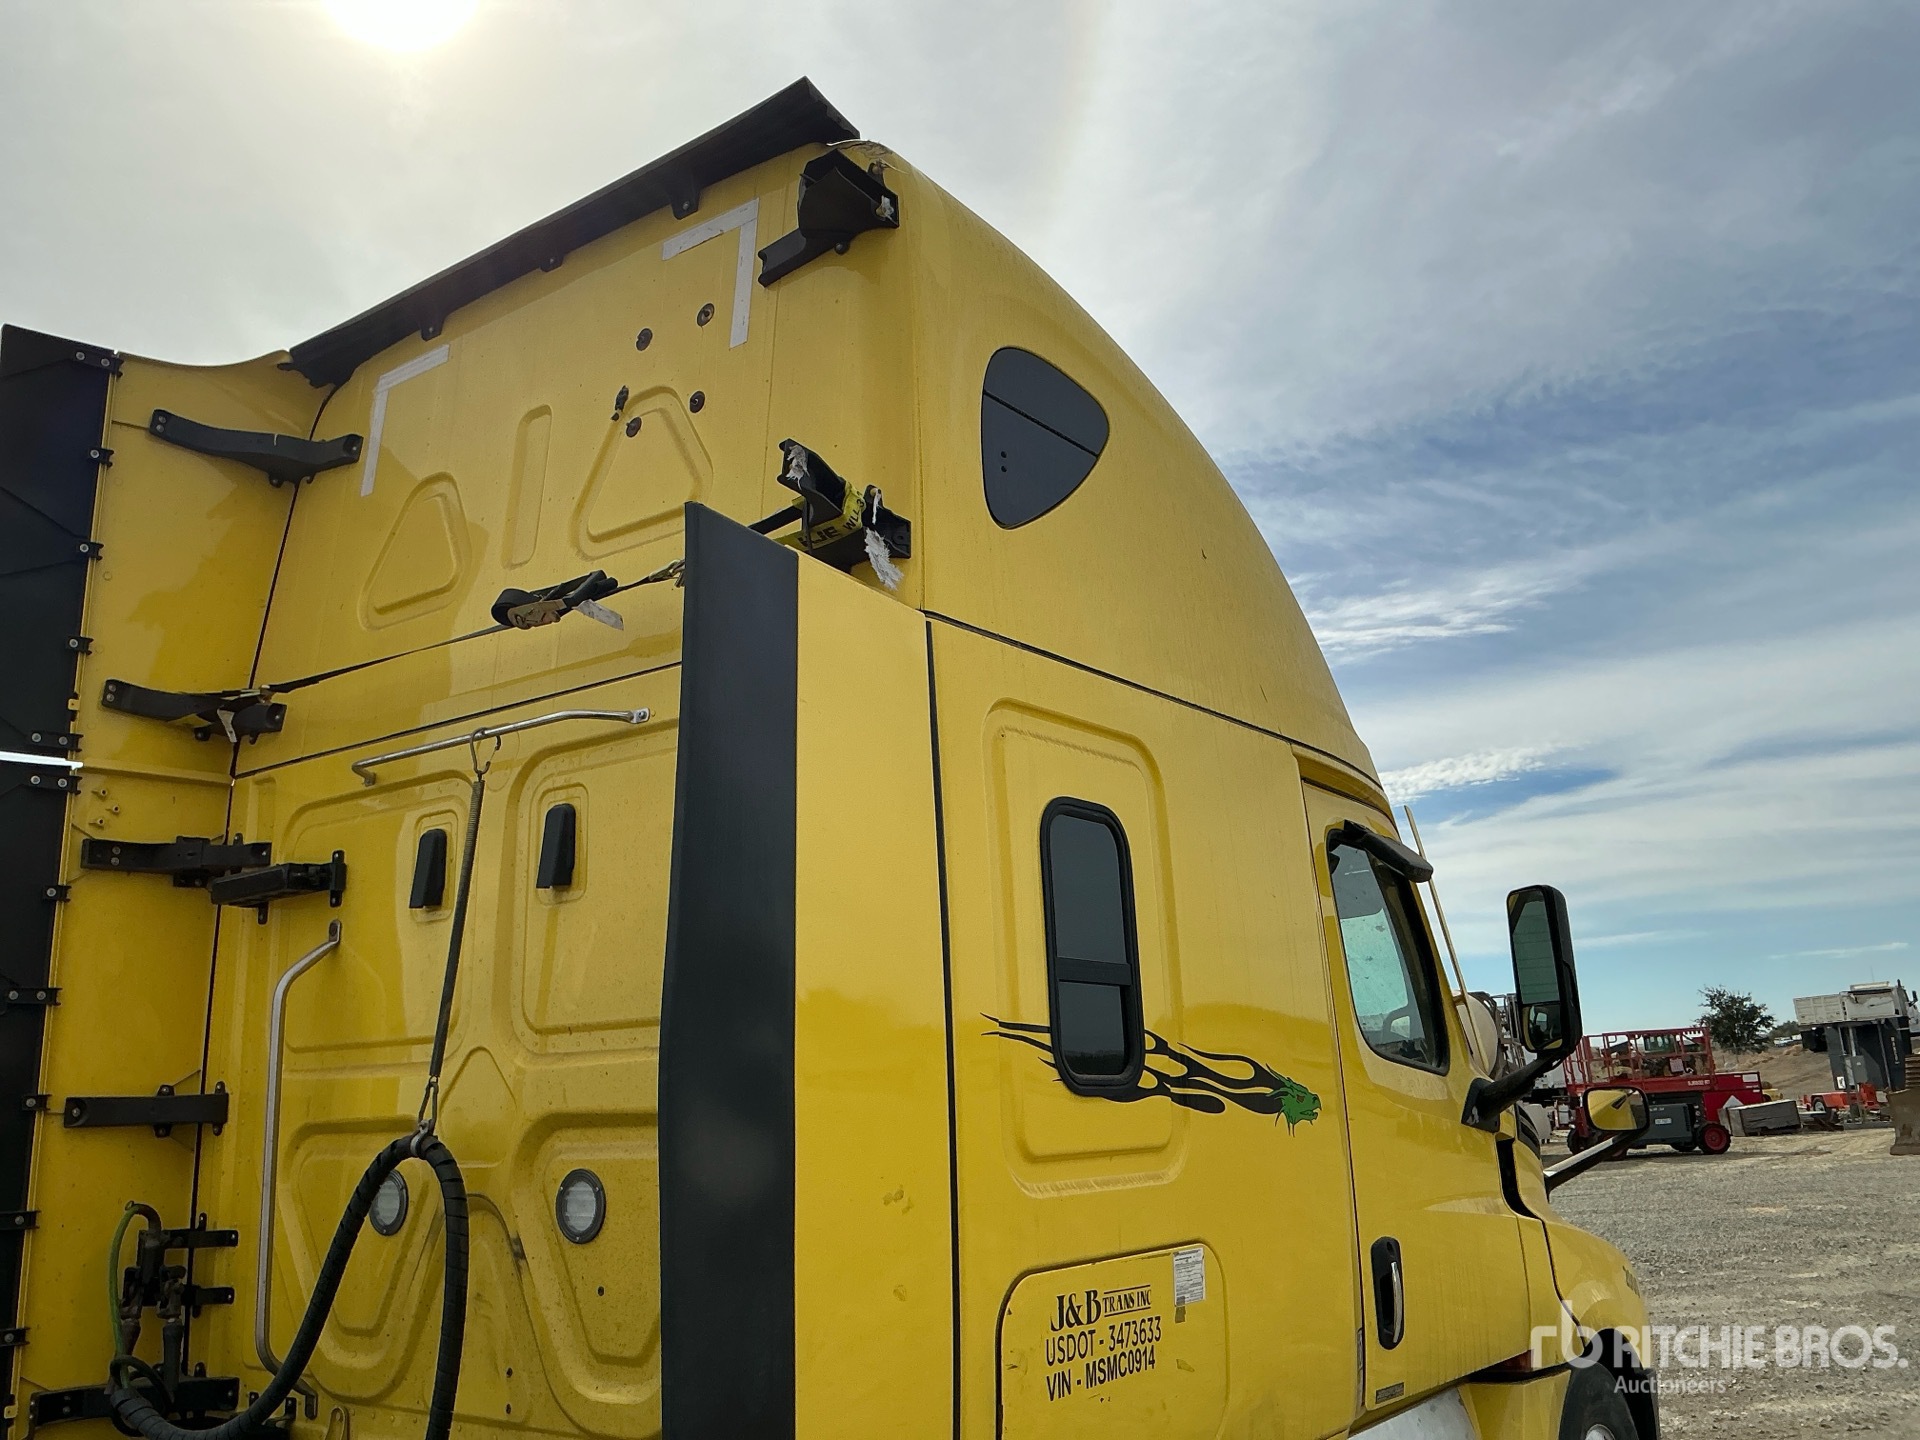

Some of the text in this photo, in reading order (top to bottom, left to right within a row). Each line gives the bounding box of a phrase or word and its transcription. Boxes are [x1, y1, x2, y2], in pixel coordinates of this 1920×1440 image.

[842, 509, 860, 530] WLL
[1050, 1289, 1152, 1332] J&B TRANS INC
[1046, 1329, 1097, 1367] USDOT
[1108, 1315, 1162, 1352] 3473633
[1046, 1368, 1072, 1402] VIN
[1085, 1344, 1156, 1390] MSMC0914
